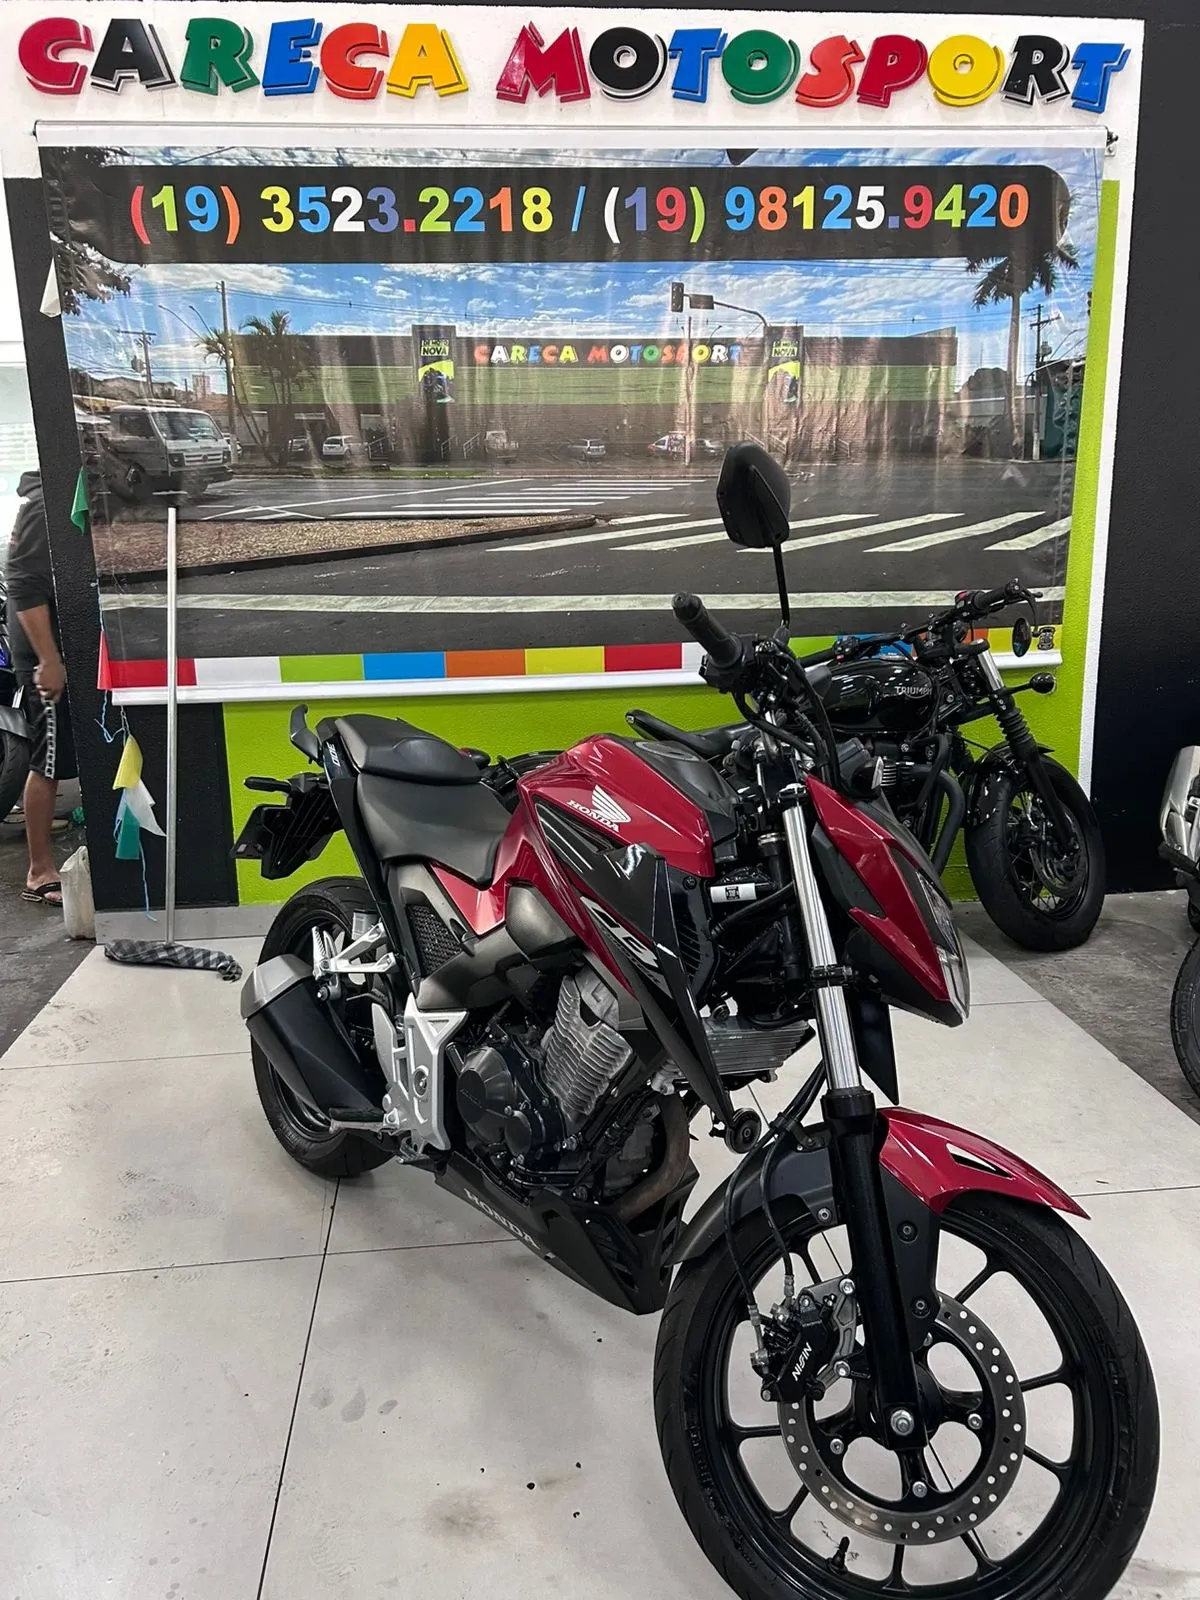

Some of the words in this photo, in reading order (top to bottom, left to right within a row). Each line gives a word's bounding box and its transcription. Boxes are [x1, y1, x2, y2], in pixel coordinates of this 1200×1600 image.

[18, 17, 469, 100] CARECA
[496, 20, 1131, 114] MOTOSPORT
[130, 184, 240, 246] (19)
[261, 185, 554, 233] 3523.2218
[572, 185, 586, 233] /
[603, 184, 706, 244] (19)
[725, 183, 1029, 232] 98125.9420
[422, 347, 447, 355] NOVA
[474, 344, 578, 364] CARECA
[587, 344, 742, 364] MOTOSPORT
[894, 686, 932, 696] TRIUMPH
[567, 800, 620, 832] HONDA
[464, 1188, 541, 1249] HONDA
[791, 1342, 813, 1381] NISSIN
